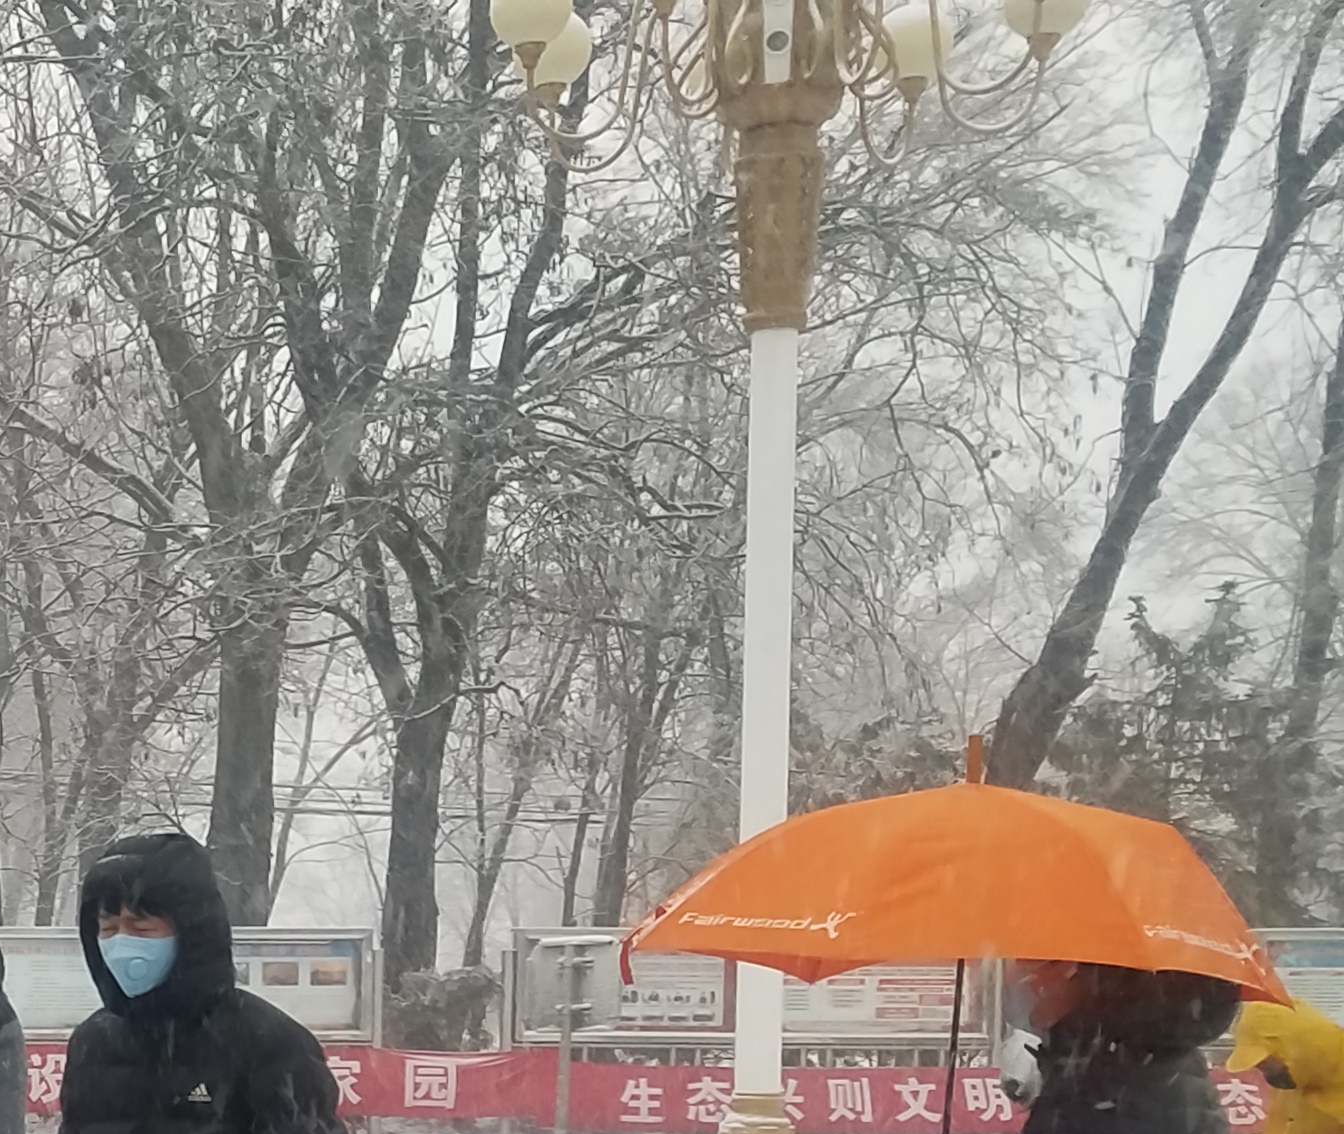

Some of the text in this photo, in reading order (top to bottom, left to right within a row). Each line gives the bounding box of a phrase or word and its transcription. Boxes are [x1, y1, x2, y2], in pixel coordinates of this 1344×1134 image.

[678, 911, 812, 930] Fairwood
[325, 1056, 458, 1110] 家园
[1216, 1078, 1269, 1125] 态
